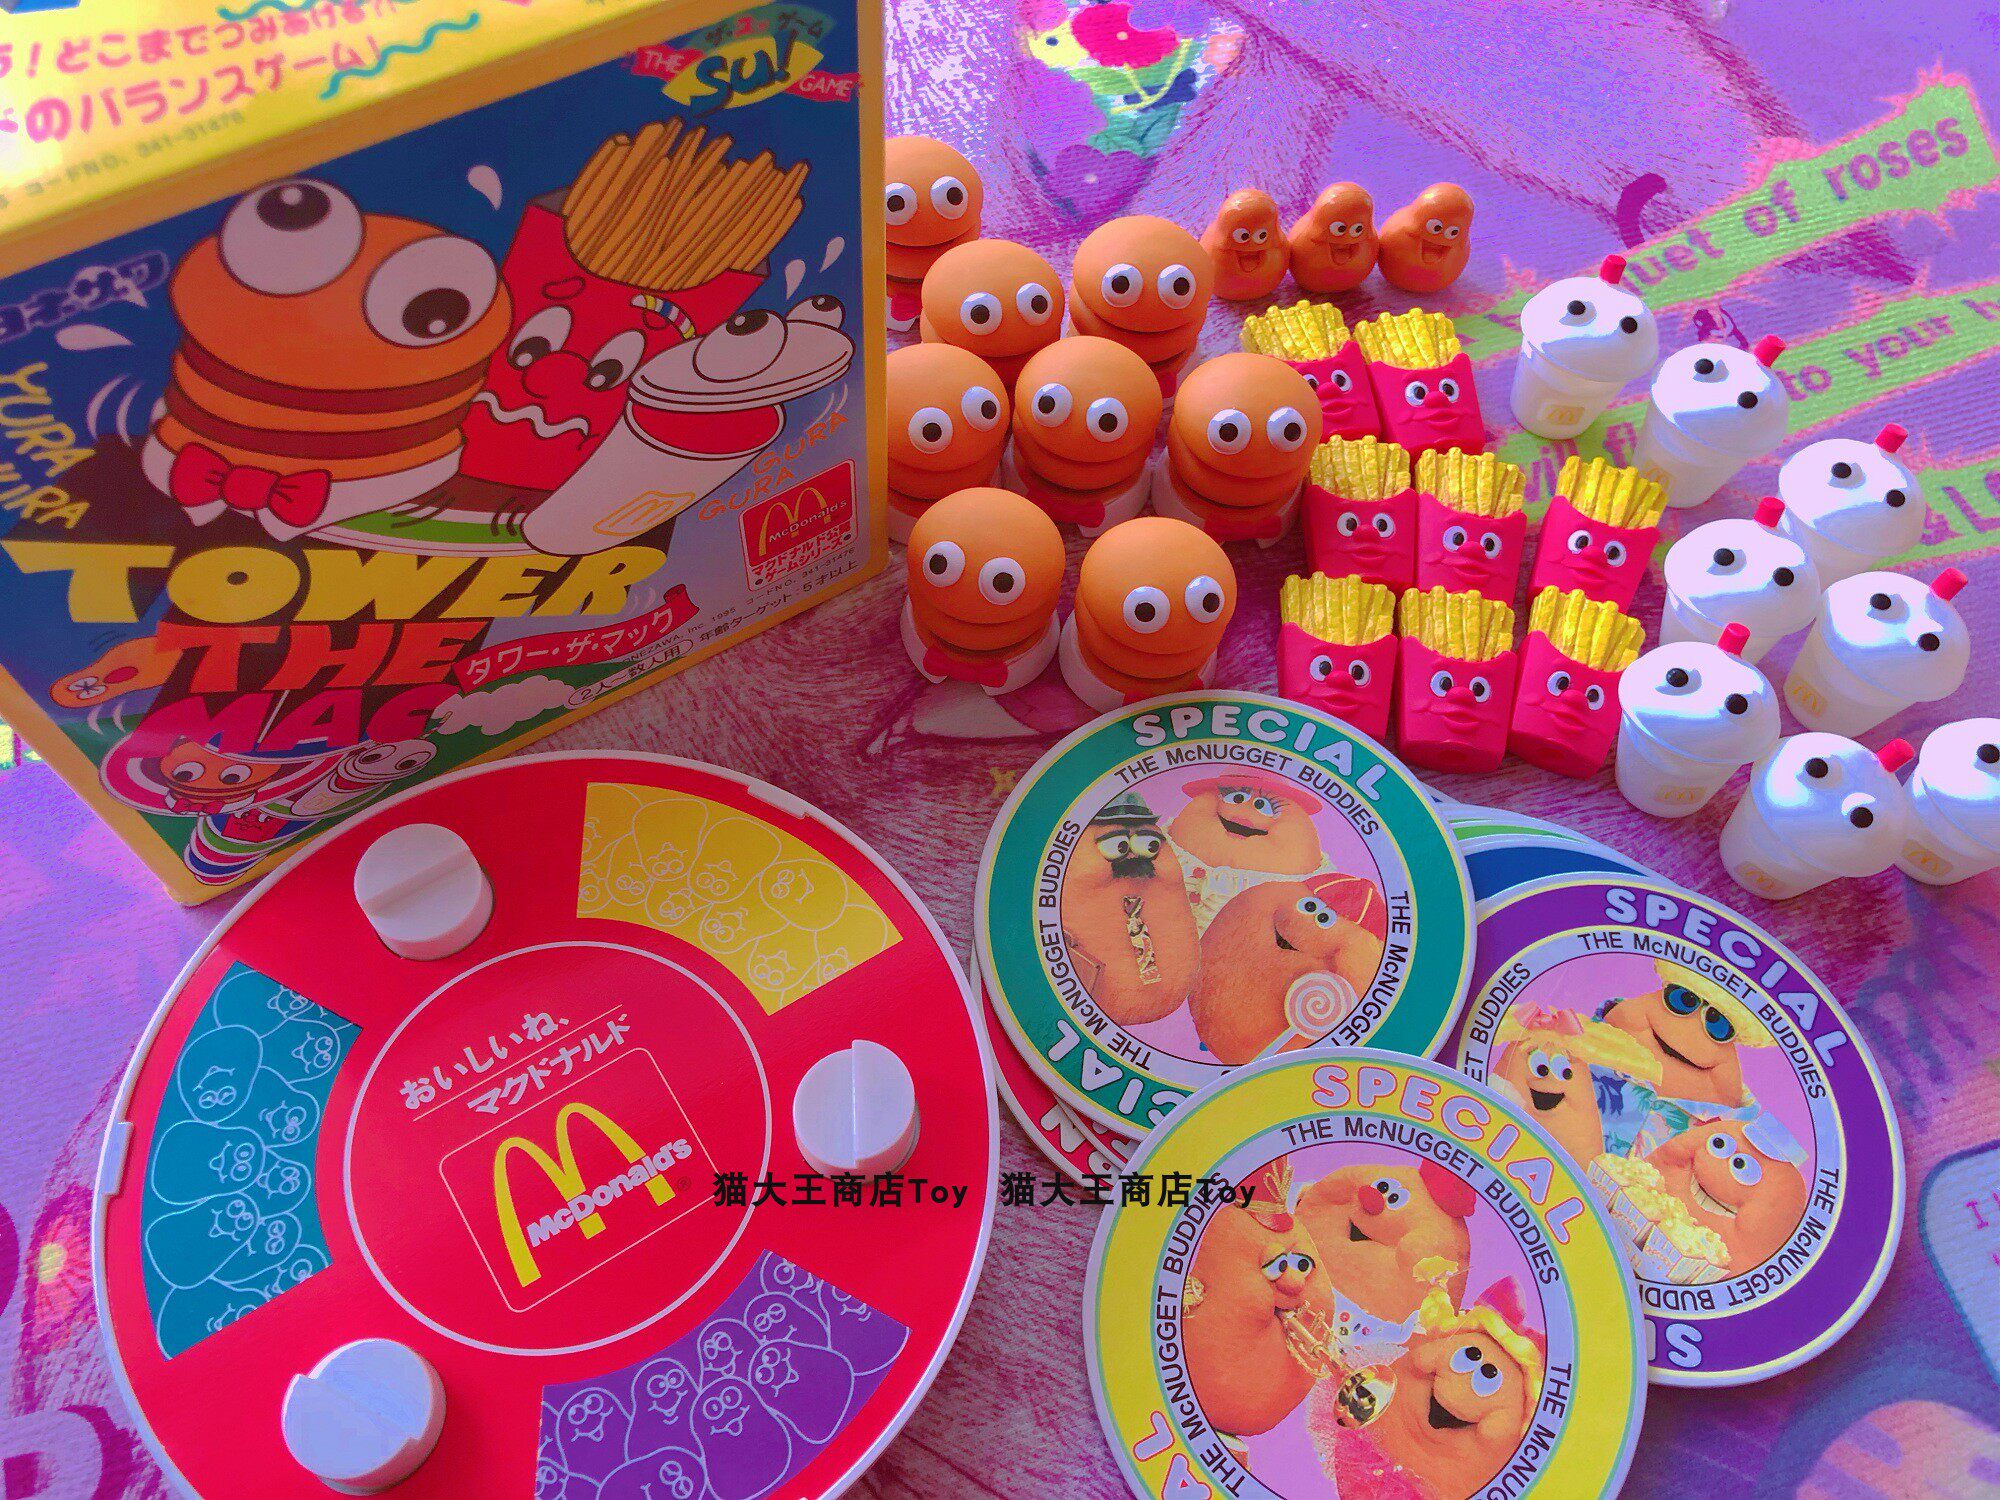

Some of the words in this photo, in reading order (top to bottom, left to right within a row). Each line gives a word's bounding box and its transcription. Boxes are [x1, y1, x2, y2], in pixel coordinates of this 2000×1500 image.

[643, 49, 684, 74] THE
[690, 28, 797, 118] SU!
[799, 74, 853, 97] GAME
[1743, 179, 1801, 239] of
[1821, 116, 1970, 203] roses
[1843, 314, 1955, 380] your
[0, 361, 95, 478] YURA
[753, 411, 848, 475] GURA
[698, 466, 795, 521] GURA
[2, 539, 668, 624] TOWER
[699, 593, 793, 643] 年齢ターゲット
[802, 560, 859, 592] 5才以上
[155, 621, 489, 693] THE
[465, 606, 675, 686] タワー・ザ・マック
[131, 682, 461, 758] MAC
[1132, 704, 1388, 802] SPECIAL
[1114, 755, 1160, 785] THE
[1165, 744, 1293, 772] McNUGGET
[1297, 765, 1380, 837] BUDDIES
[1038, 819, 1081, 909] BUDDIES
[1390, 890, 1411, 935] THE
[1038, 919, 1108, 1037] McNUGGET
[1469, 962, 1531, 1045] BUDDIES
[1577, 931, 1624, 951] THE
[1633, 933, 1758, 1000] McNUGGET
[1757, 1003, 1827, 1100] BUDDIES
[1604, 887, 1848, 1068] SPECIAL
[399, 1011, 570, 1110] おいしいね、
[467, 1012, 632, 1115] マクドナルド
[1106, 1031, 1152, 1072] THE
[525, 1137, 694, 1248] McDonald's
[1310, 1064, 1586, 1245] SPECIAL
[1813, 1168, 1840, 1215] THE
[1162, 1172, 1230, 1276] BUDDIES
[1281, 1117, 1334, 1146] THE
[1344, 1116, 1485, 1179] McNUGGET
[1484, 1178, 1560, 1286] BUDDIES
[1638, 1284, 1716, 1311] BUDDI
[1726, 1215, 1827, 1307] McNUGGET
[1156, 1285, 1207, 1442] McNUGGET
[1542, 1363, 1573, 1419] THE
[1199, 1442, 1247, 1499] THE
